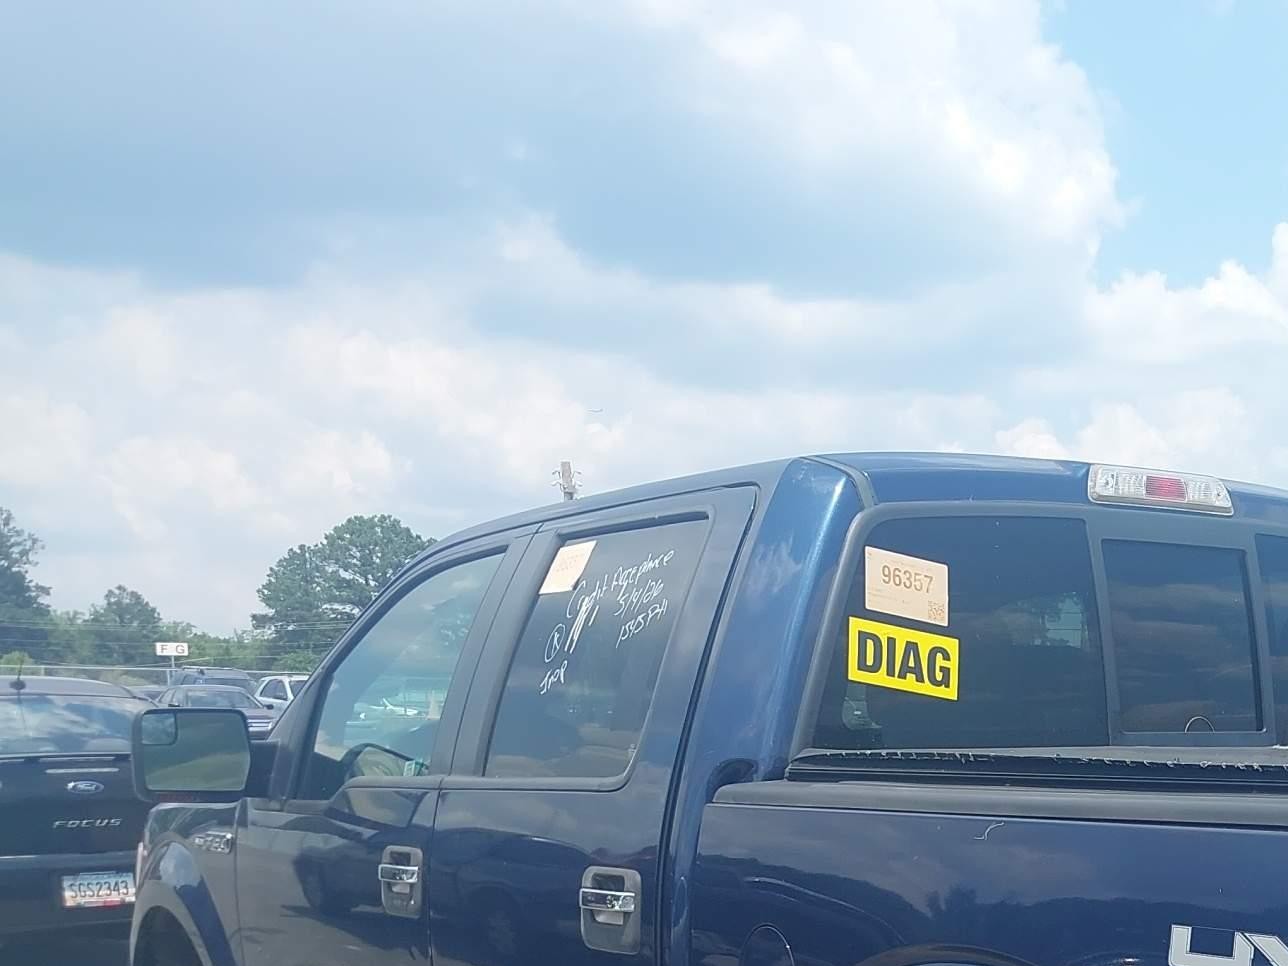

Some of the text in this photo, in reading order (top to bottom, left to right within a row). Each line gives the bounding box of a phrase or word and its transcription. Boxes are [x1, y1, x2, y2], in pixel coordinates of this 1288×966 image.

[881, 565, 934, 594] 96357
[160, 644, 185, 654] F G
[857, 629, 952, 688] DIAG
[53, 818, 122, 829] FOCUS
